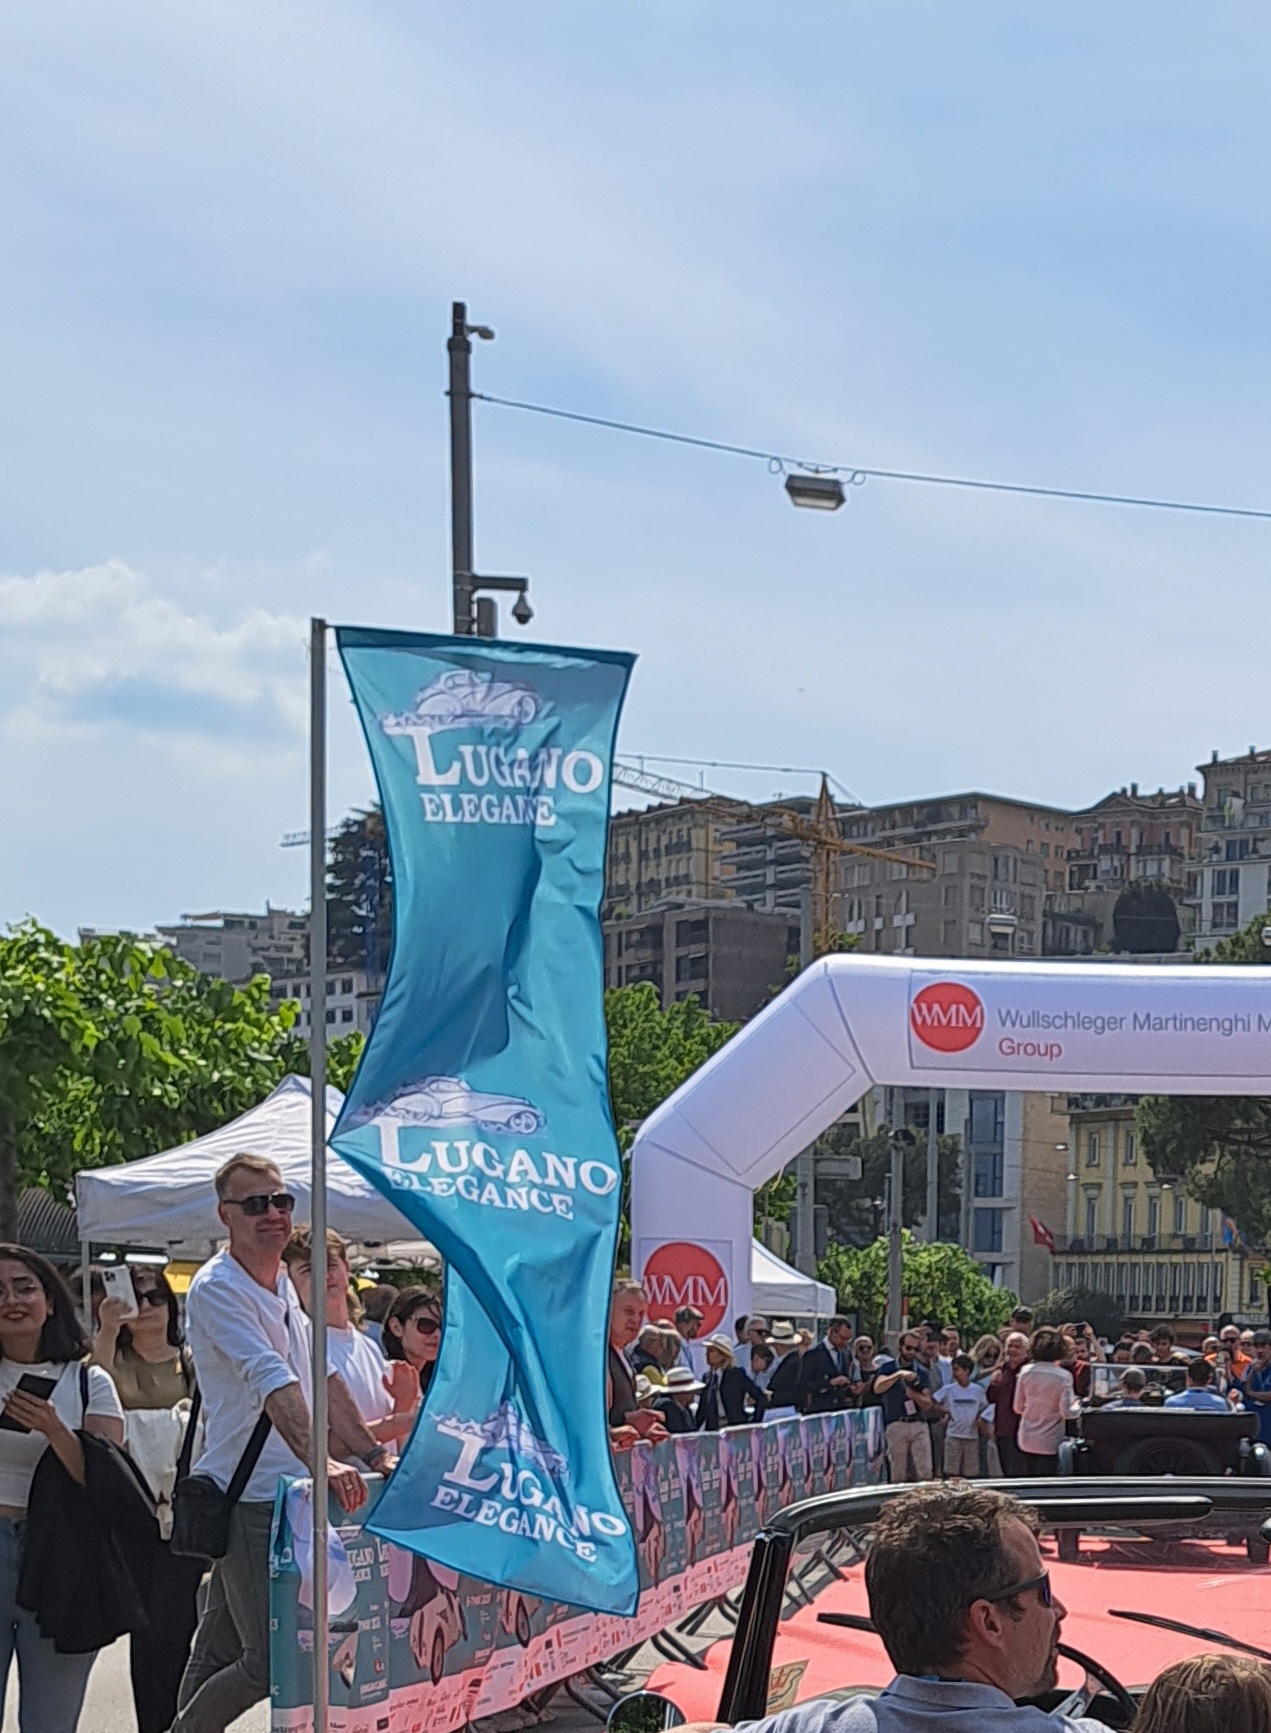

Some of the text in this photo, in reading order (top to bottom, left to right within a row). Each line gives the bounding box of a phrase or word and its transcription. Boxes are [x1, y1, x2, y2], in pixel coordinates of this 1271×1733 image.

[420, 792, 558, 826] ELEGANE
[912, 1001, 984, 1029] WMM
[998, 1008, 1126, 1035] Wullschleger
[1133, 1012, 1252, 1037] Martinenghi
[999, 1038, 1063, 1060] Group
[362, 1117, 618, 1197] LUGANO
[381, 1166, 575, 1221] ELEGANCE
[643, 1273, 726, 1307] WMM
[437, 1424, 627, 1537] LUGANO
[430, 1485, 598, 1563] ELEGANCE
